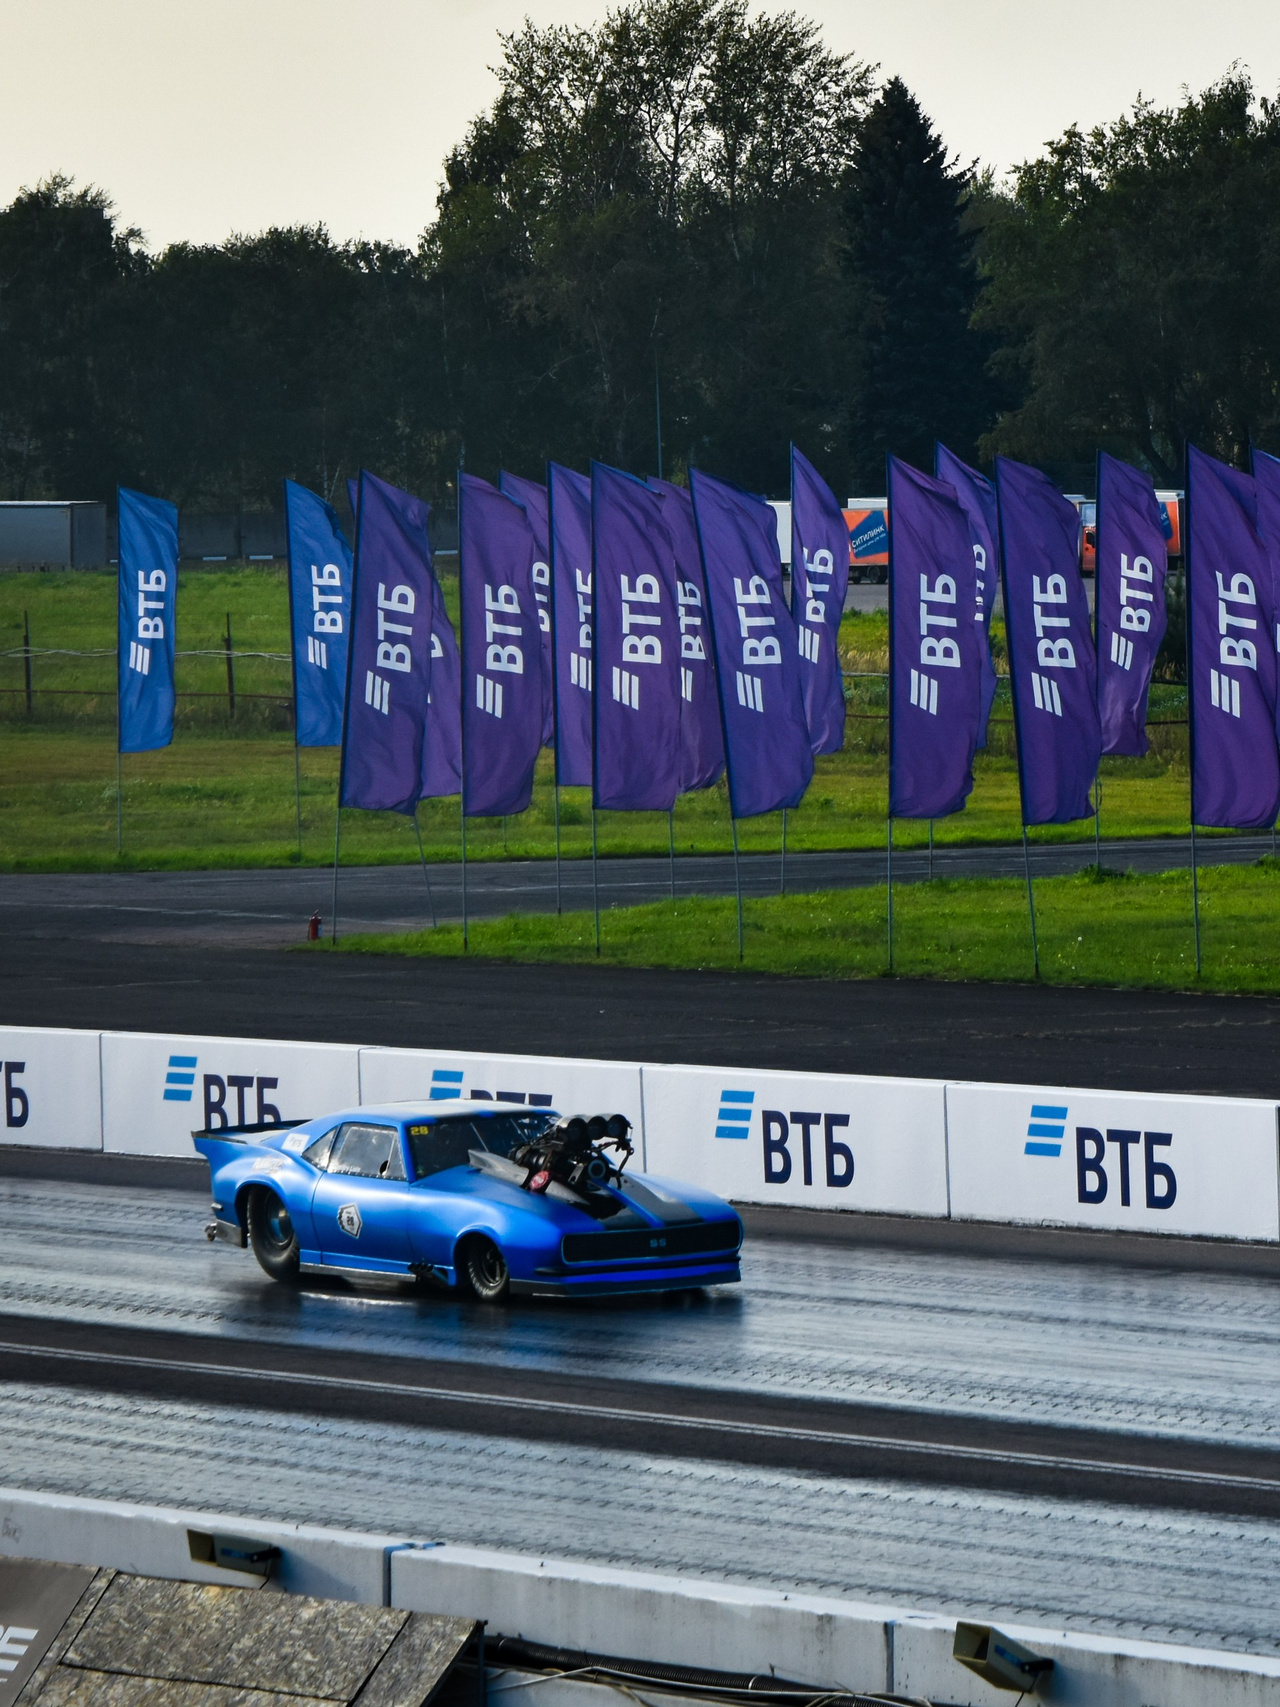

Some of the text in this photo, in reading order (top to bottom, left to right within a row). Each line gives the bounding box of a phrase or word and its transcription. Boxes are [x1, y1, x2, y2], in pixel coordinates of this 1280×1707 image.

[138, 569, 167, 639] ВТБ
[311, 564, 343, 634] ВТБ
[621, 573, 662, 665] ВТБ
[677, 581, 706, 660] ВТБ
[734, 575, 782, 665] ВТБ
[803, 547, 834, 623] ВТБ
[920, 573, 961, 668] ВТБ
[1033, 573, 1076, 668] ВТБ
[1120, 553, 1154, 633] ВТБ
[1216, 570, 1257, 671] ВТБ
[377, 582, 415, 673] ВТБ
[485, 583, 524, 674] ВТБ
[0, 1061, 29, 1128] Б
[203, 1074, 281, 1129] ВТБ
[410, 1126, 429, 1135] 28
[762, 1110, 854, 1188] ВТБ
[1075, 1127, 1177, 1209] ВТБ
[650, 1238, 667, 1247] SS
